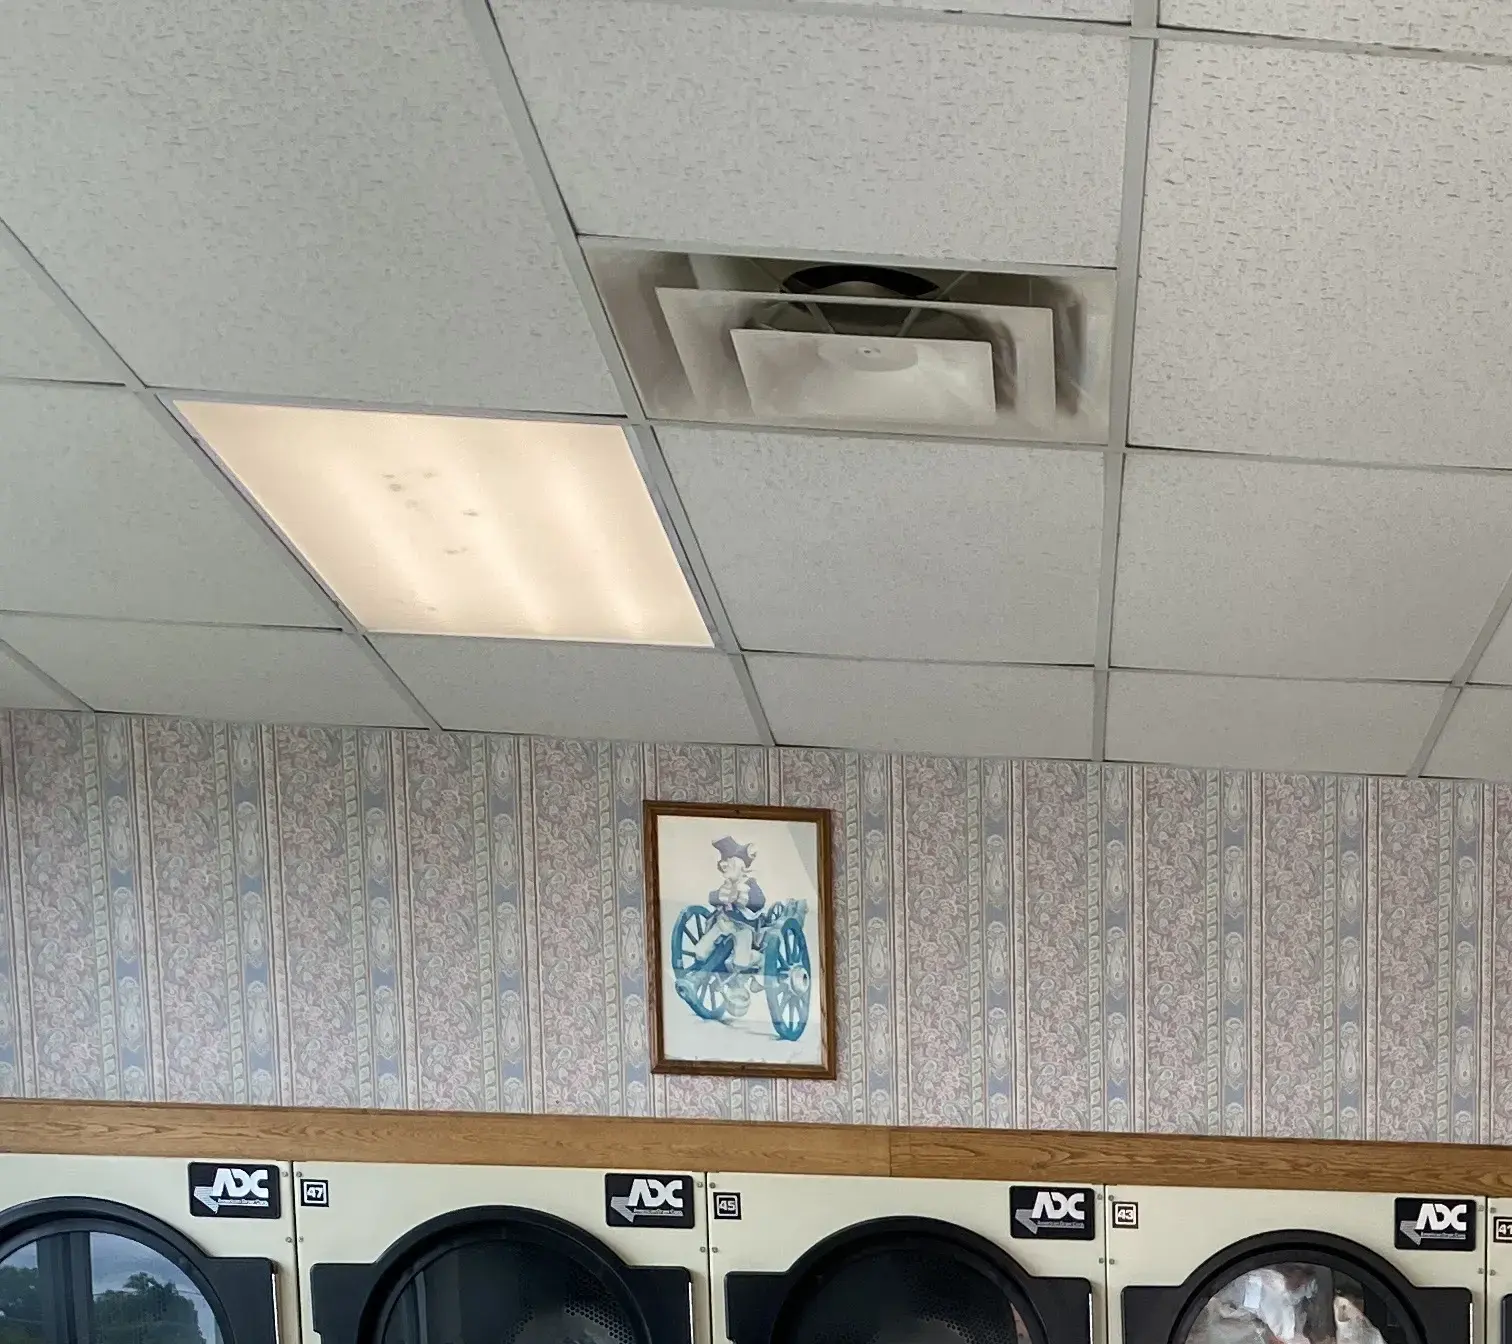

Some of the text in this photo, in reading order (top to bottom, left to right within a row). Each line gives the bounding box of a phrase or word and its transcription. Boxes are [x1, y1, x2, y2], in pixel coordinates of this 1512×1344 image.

[212, 1168, 269, 1198] ADC
[306, 1186, 324, 1199] 47
[627, 1179, 683, 1208] ADC
[719, 1200, 736, 1211] 45
[1031, 1191, 1085, 1220] ADC
[1117, 1209, 1134, 1220] 43
[1414, 1203, 1467, 1231] ADC
